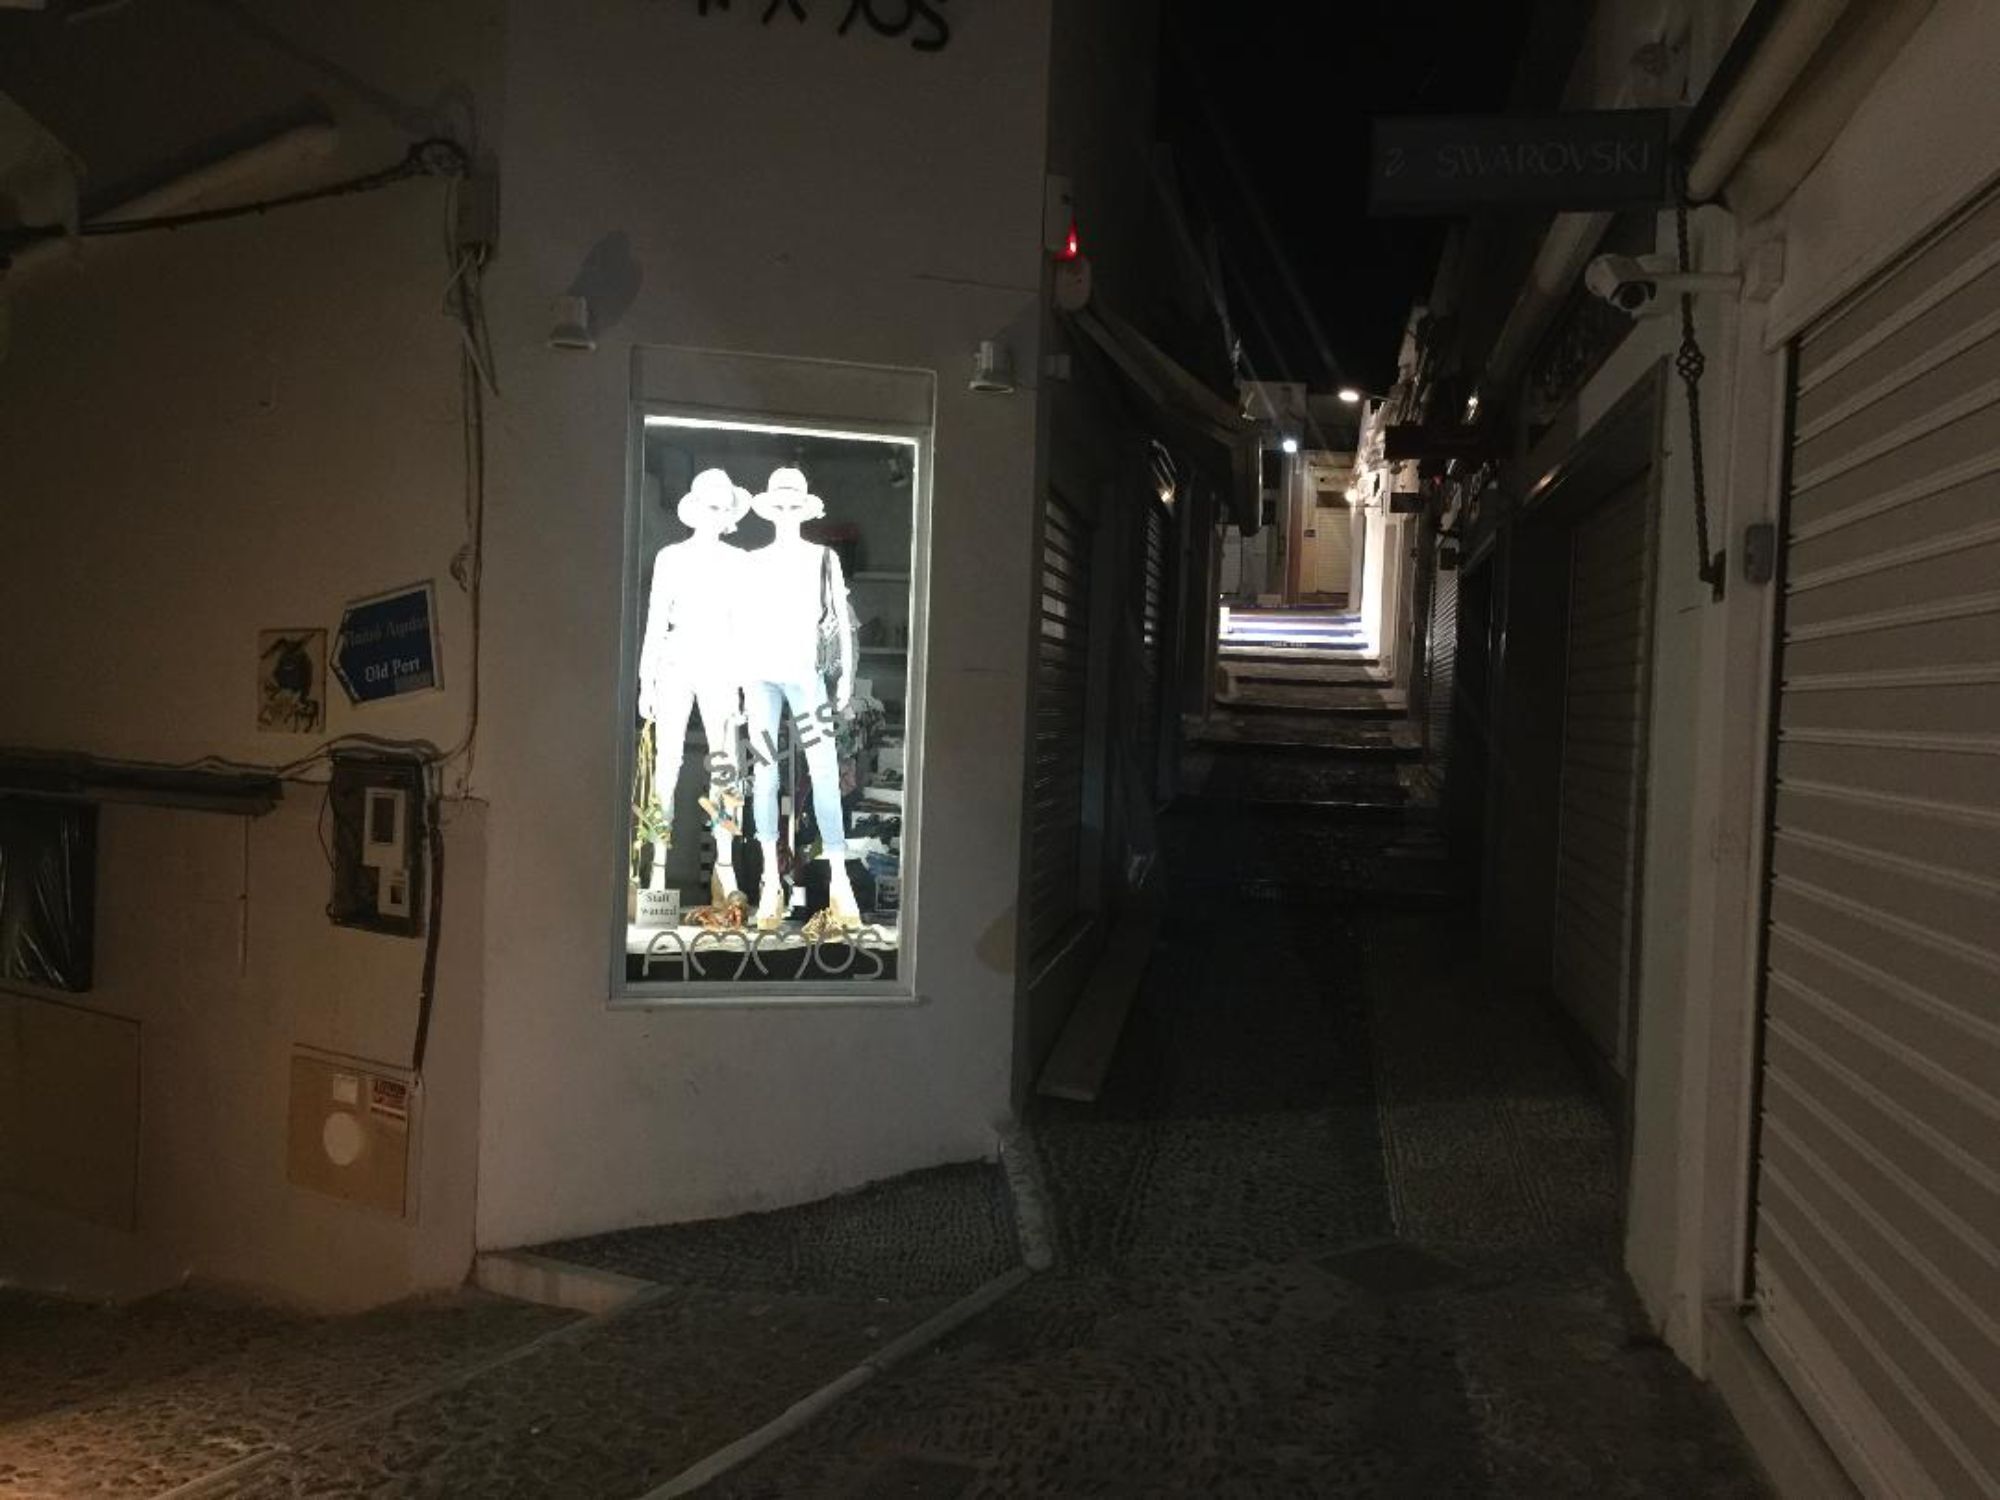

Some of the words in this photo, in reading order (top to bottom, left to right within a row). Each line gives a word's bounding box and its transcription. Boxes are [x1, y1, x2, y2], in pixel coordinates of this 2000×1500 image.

[1435, 139, 1651, 179] SWAROVSKI
[364, 661, 389, 682] Old
[392, 656, 420, 675] Port
[704, 698, 840, 787] SALES
